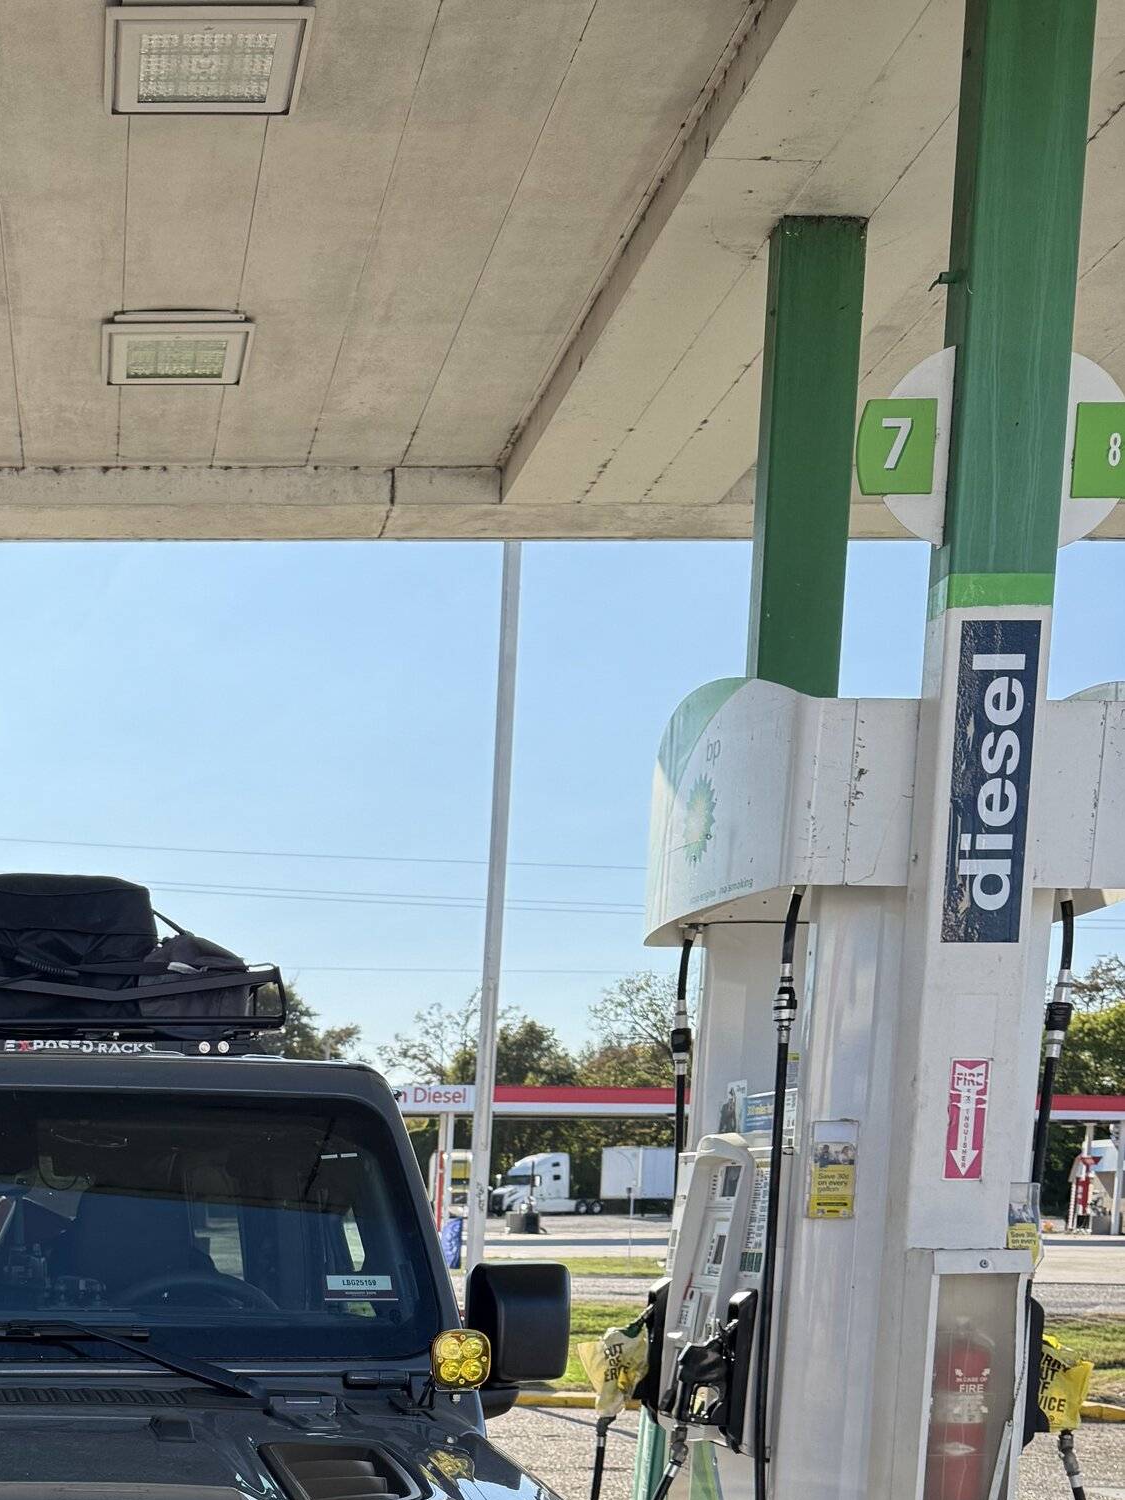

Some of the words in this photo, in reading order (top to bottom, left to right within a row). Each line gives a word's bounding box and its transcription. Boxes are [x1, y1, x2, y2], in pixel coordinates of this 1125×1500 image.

[881, 417, 914, 470] 7
[1108, 432, 1122, 467] 8
[706, 737, 722, 767] bp
[958, 653, 1026, 921] diesel
[98, 1042, 155, 1054] RACKS
[956, 1072, 984, 1087] FIRE
[413, 1086, 467, 1104] Diesel
[828, 1180, 848, 1188] every
[959, 1384, 984, 1393] FIRE
